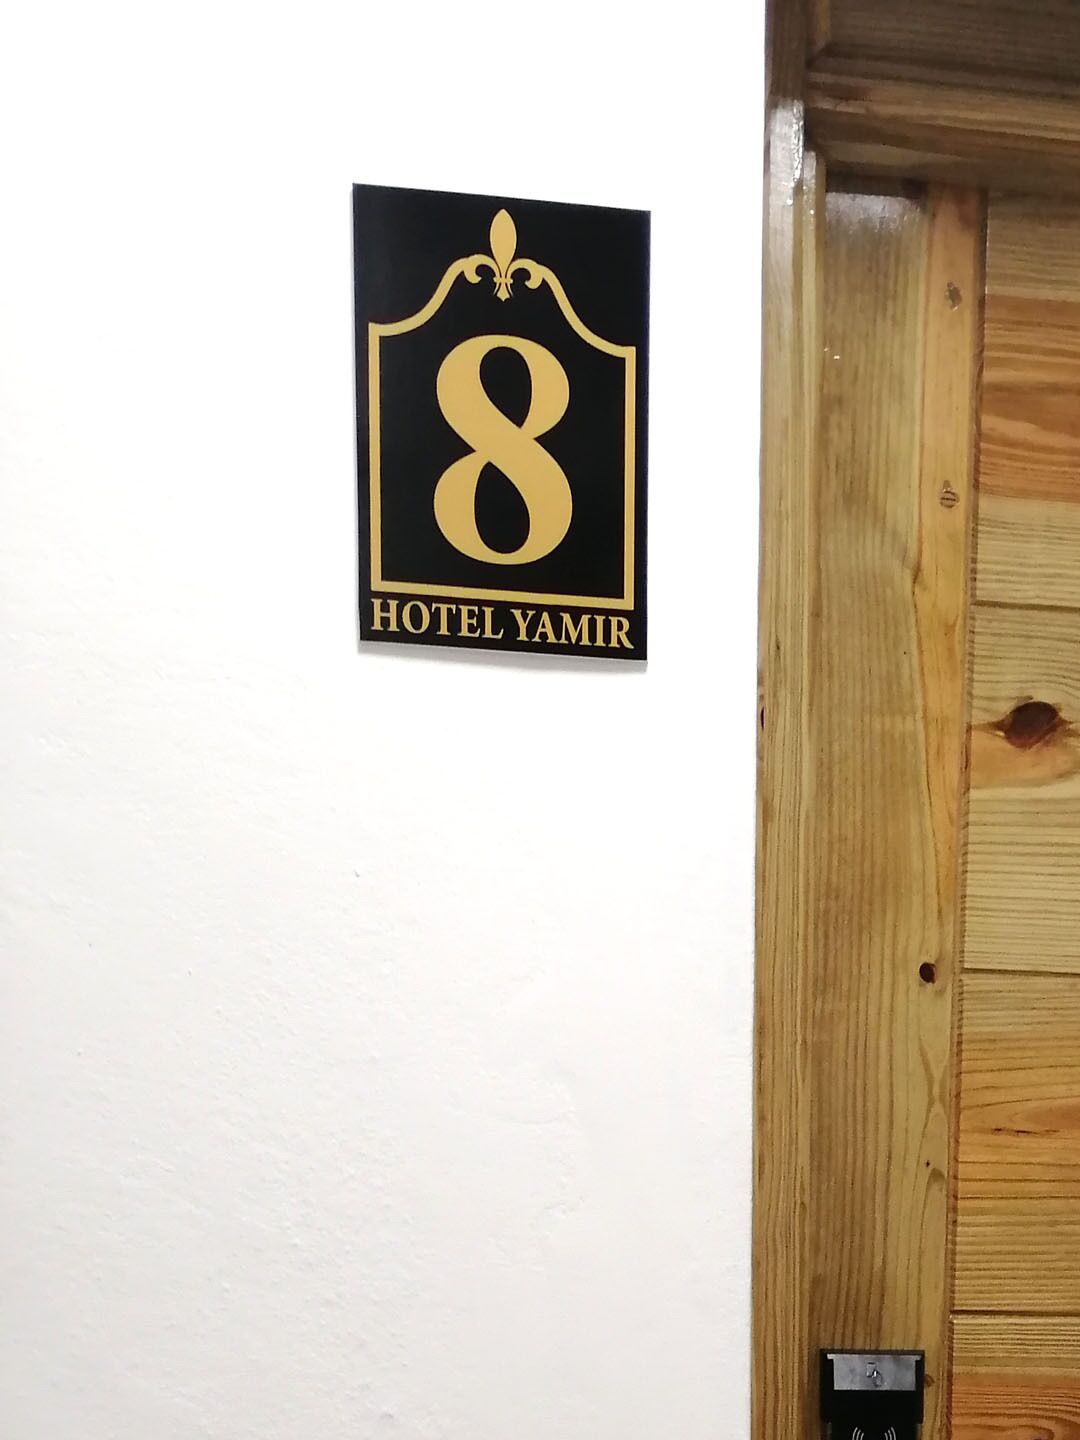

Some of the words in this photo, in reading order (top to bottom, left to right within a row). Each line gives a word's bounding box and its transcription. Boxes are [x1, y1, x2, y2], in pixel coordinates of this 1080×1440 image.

[433, 334, 573, 565] 8
[371, 598, 505, 640] HOTEL
[511, 607, 635, 649] YAMIR
